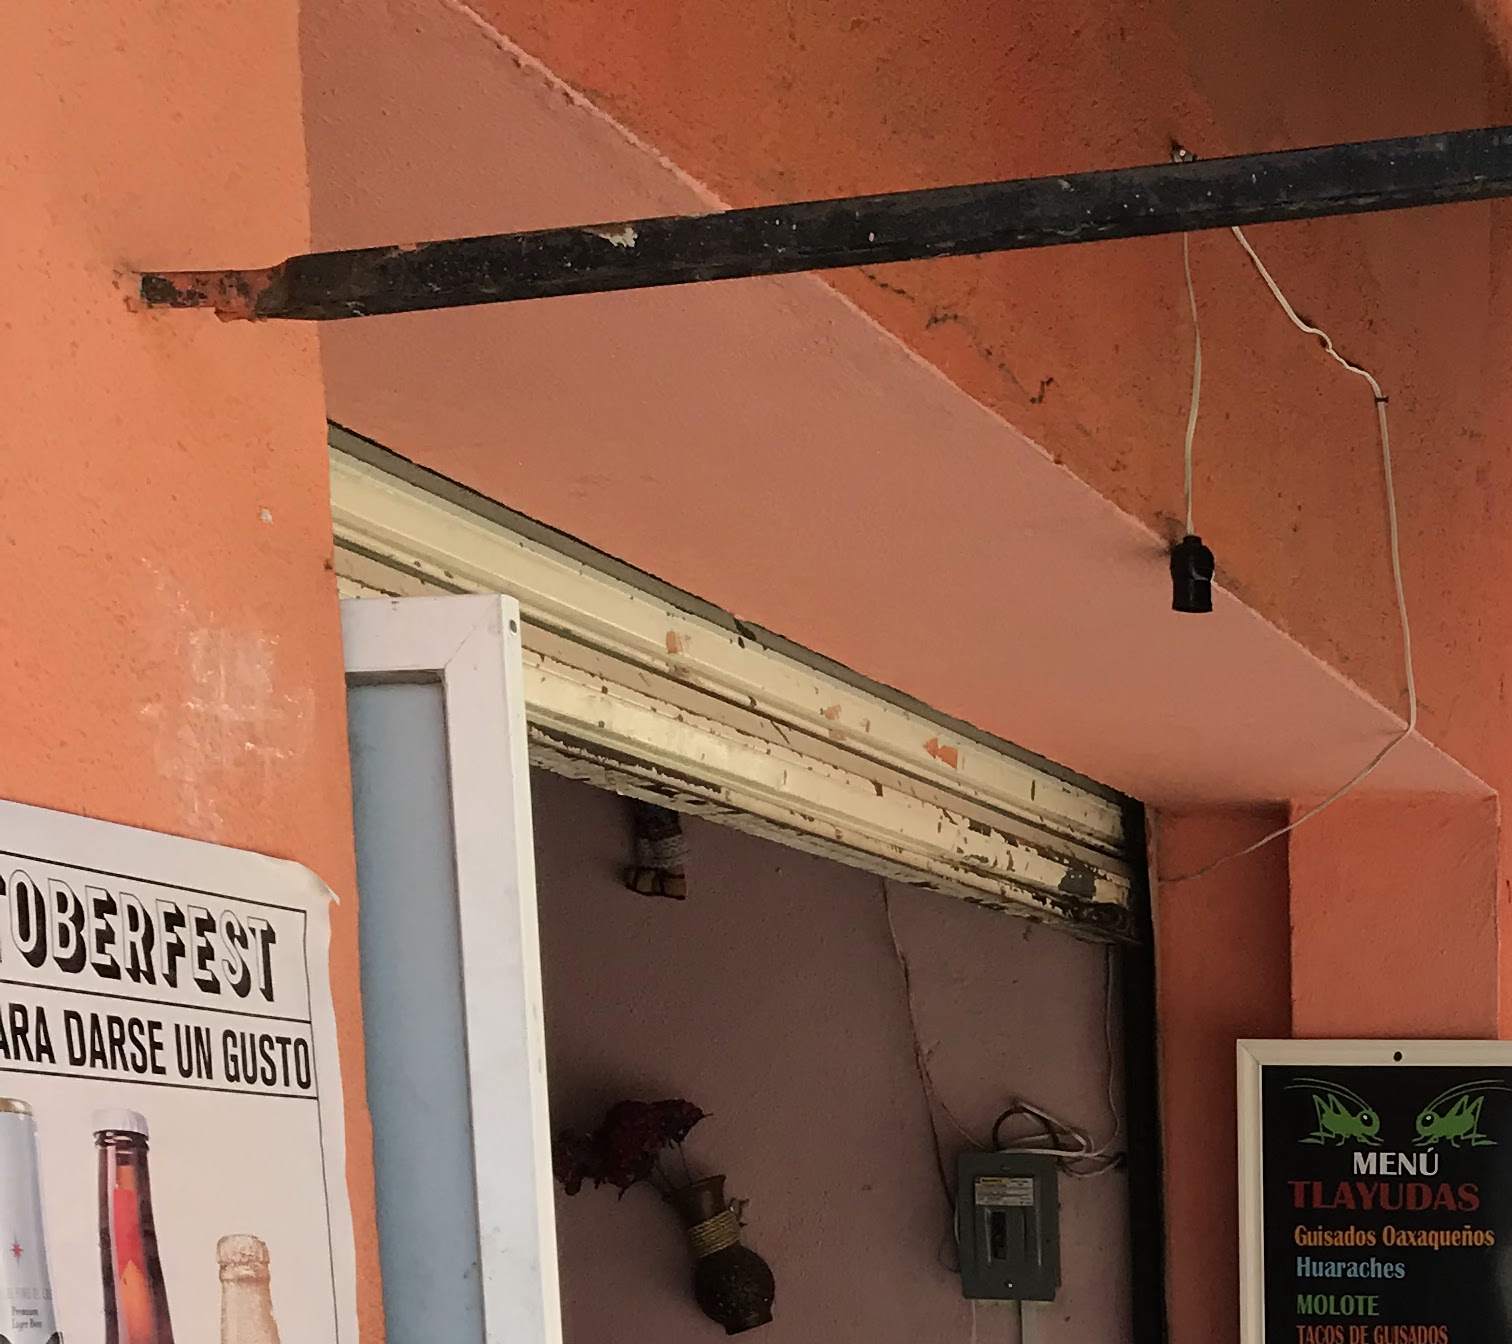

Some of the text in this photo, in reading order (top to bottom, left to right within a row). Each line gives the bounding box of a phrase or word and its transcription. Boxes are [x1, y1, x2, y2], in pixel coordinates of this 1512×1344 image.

[0, 869, 277, 1002] OBERFEST
[65, 1010, 167, 1076] DARSE
[175, 1023, 213, 1080] UN
[223, 1028, 312, 1090] GUSTO
[1353, 1147, 1439, 1176] MENÚ
[1287, 1181, 1480, 1212] TLAYUDAS
[1294, 1224, 1496, 1250] Guisados Oaxaqueños
[1296, 1256, 1406, 1279] Huaraches
[1296, 1294, 1380, 1317] MOLOTE
